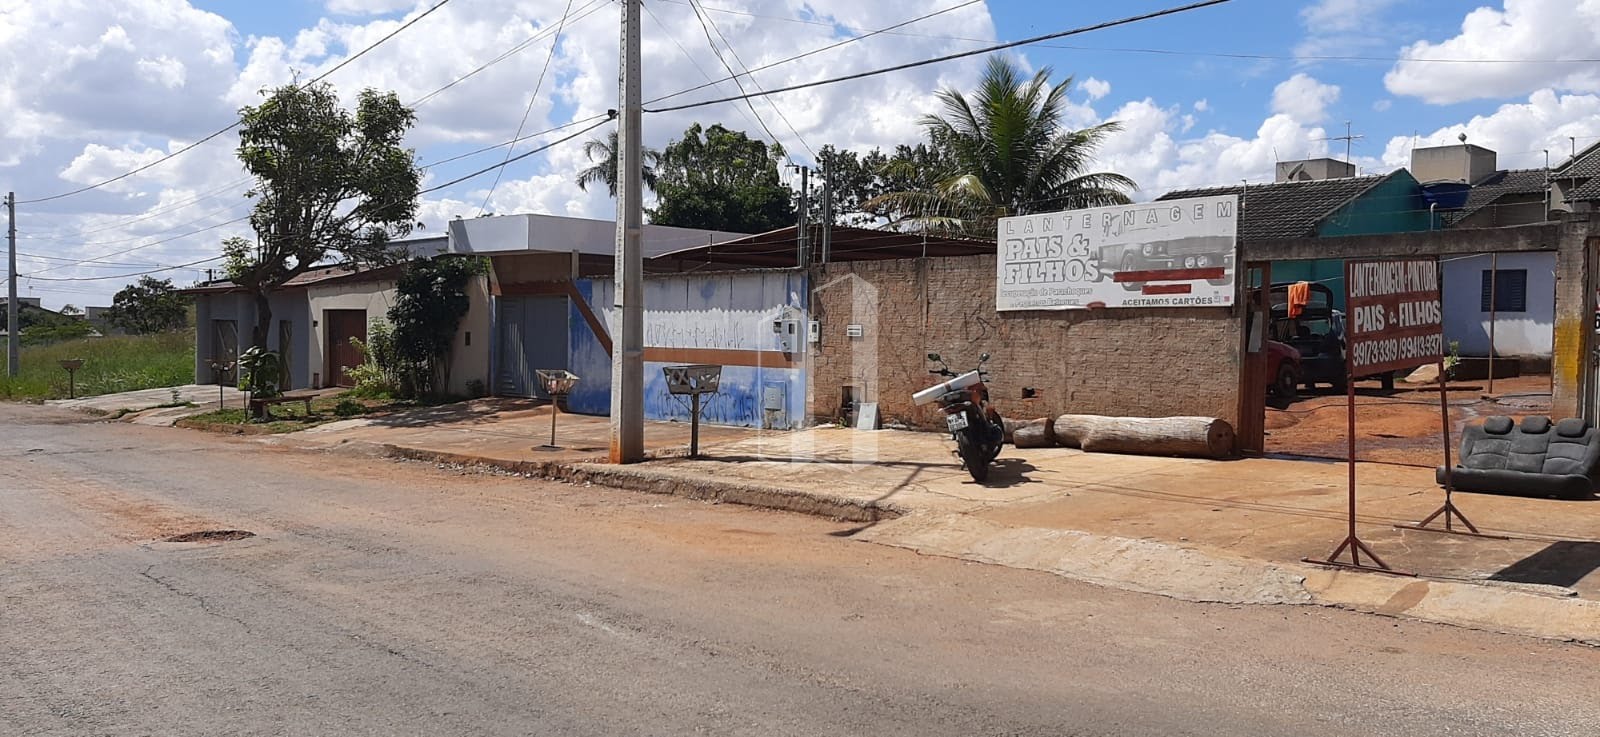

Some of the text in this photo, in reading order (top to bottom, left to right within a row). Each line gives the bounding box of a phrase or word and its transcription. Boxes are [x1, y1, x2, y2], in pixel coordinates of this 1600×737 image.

[1006, 201, 1233, 234] LANTERNAGEM
[1006, 233, 1090, 261] PAIS &
[1003, 259, 1100, 285] FILHOS
[1122, 298, 1170, 306] ACEITAMOS
[1172, 296, 1213, 305] CARTÕES
[1354, 304, 1385, 334] PAIS
[1399, 300, 1442, 328] FILHOS
